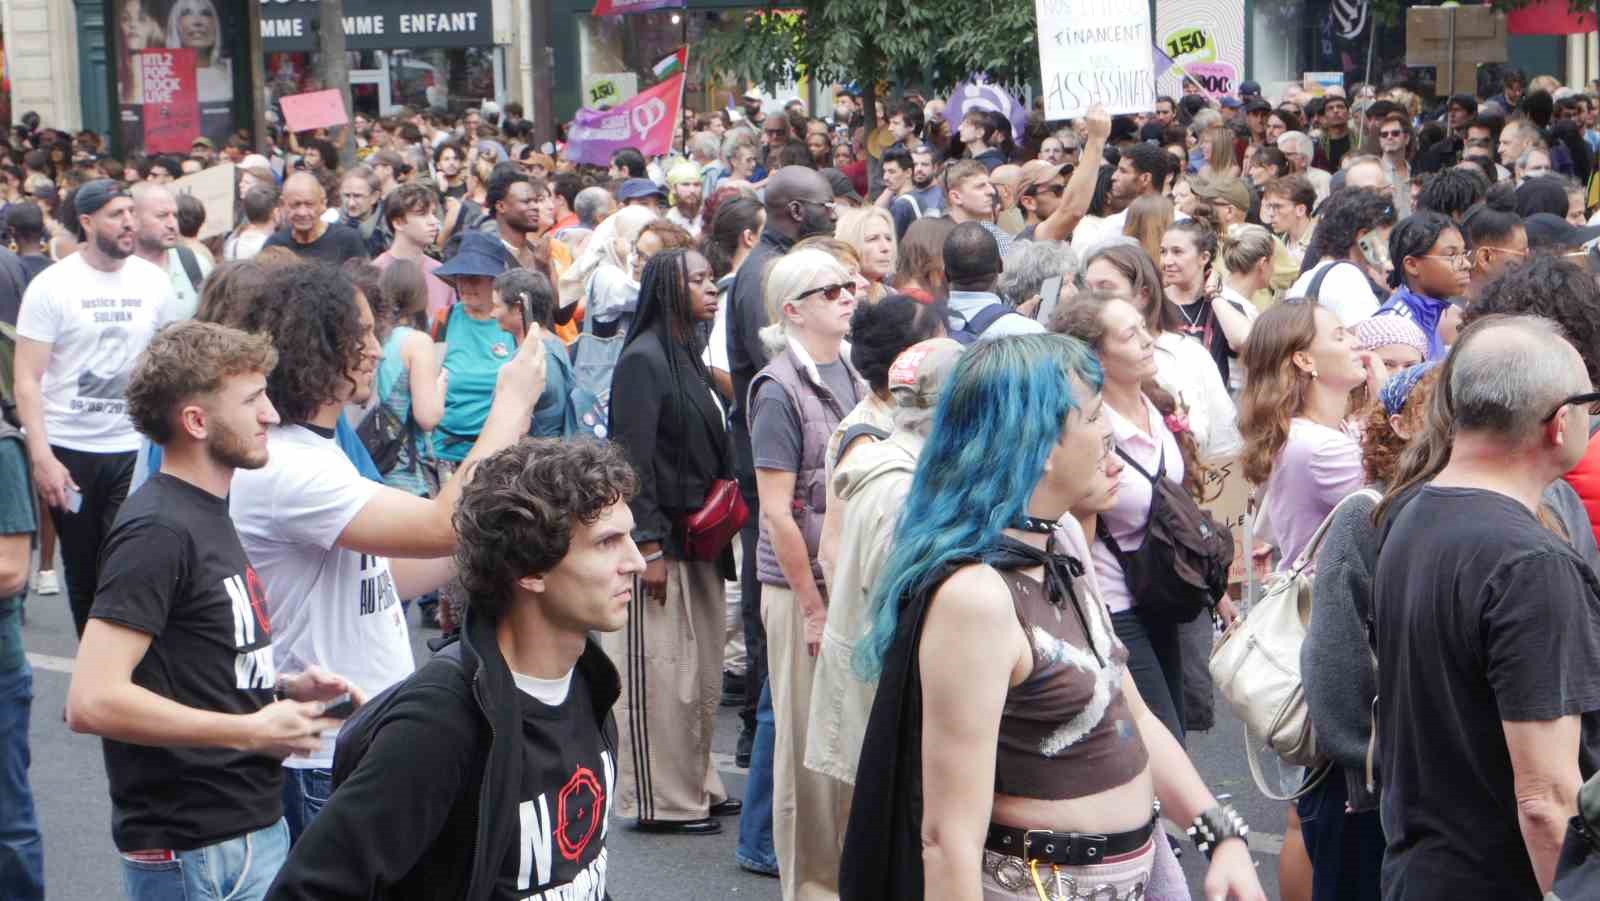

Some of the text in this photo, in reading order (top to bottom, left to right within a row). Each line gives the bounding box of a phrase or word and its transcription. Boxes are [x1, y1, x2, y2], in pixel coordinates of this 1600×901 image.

[260, 19, 303, 37] MME
[400, 13, 477, 33] ENFANT
[1054, 24, 1144, 47] FINANCENT
[144, 78, 180, 91] ROCK
[144, 90, 173, 104] LIVE
